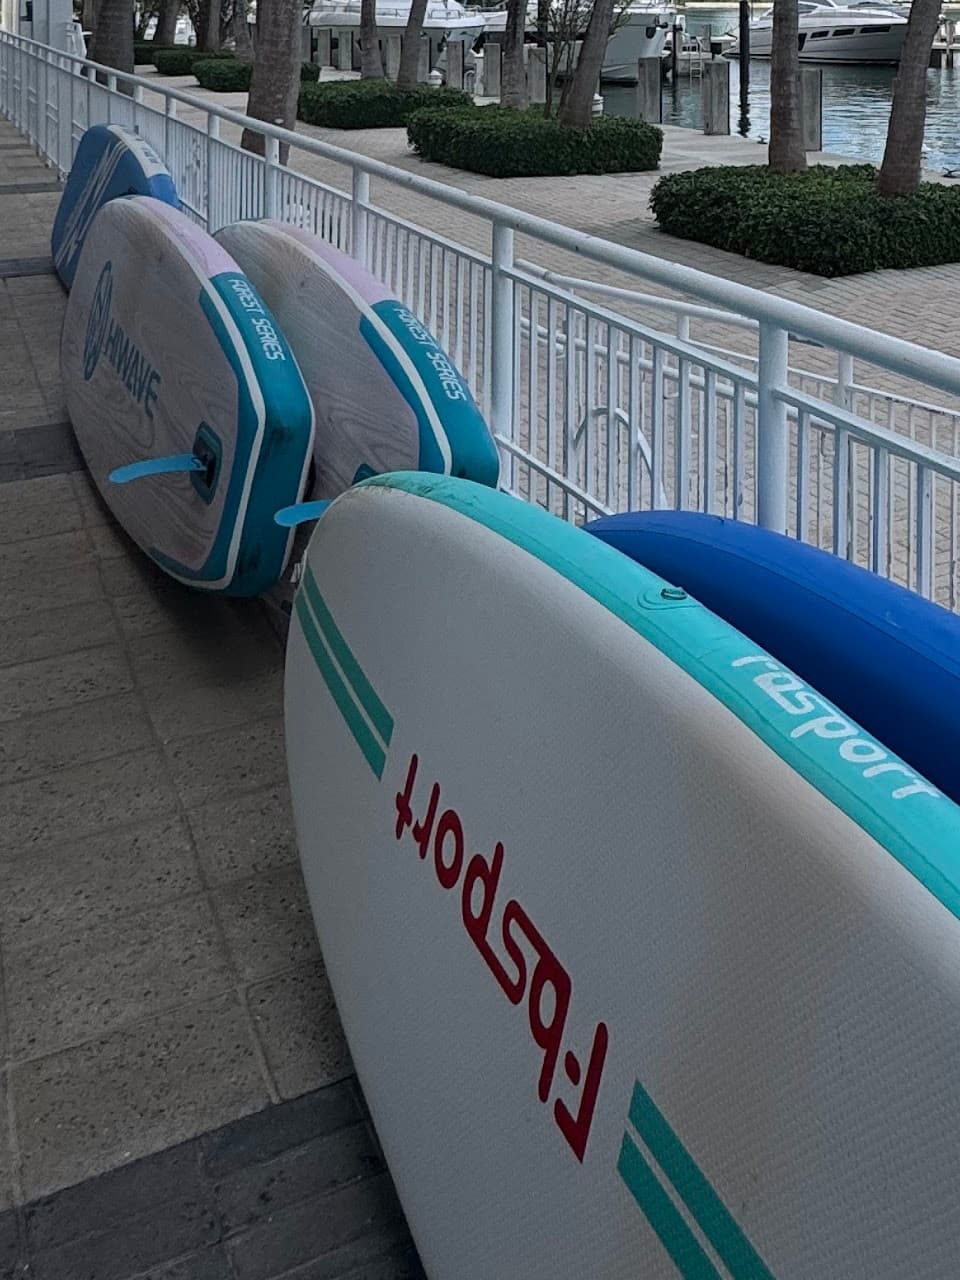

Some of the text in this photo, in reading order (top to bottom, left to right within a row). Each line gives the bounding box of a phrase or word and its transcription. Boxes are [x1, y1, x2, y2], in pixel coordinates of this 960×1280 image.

[229, 279, 286, 360] FOREST SERIES
[393, 307, 467, 401] FOREST SERIES
[104, 319, 161, 419] HIWAVE
